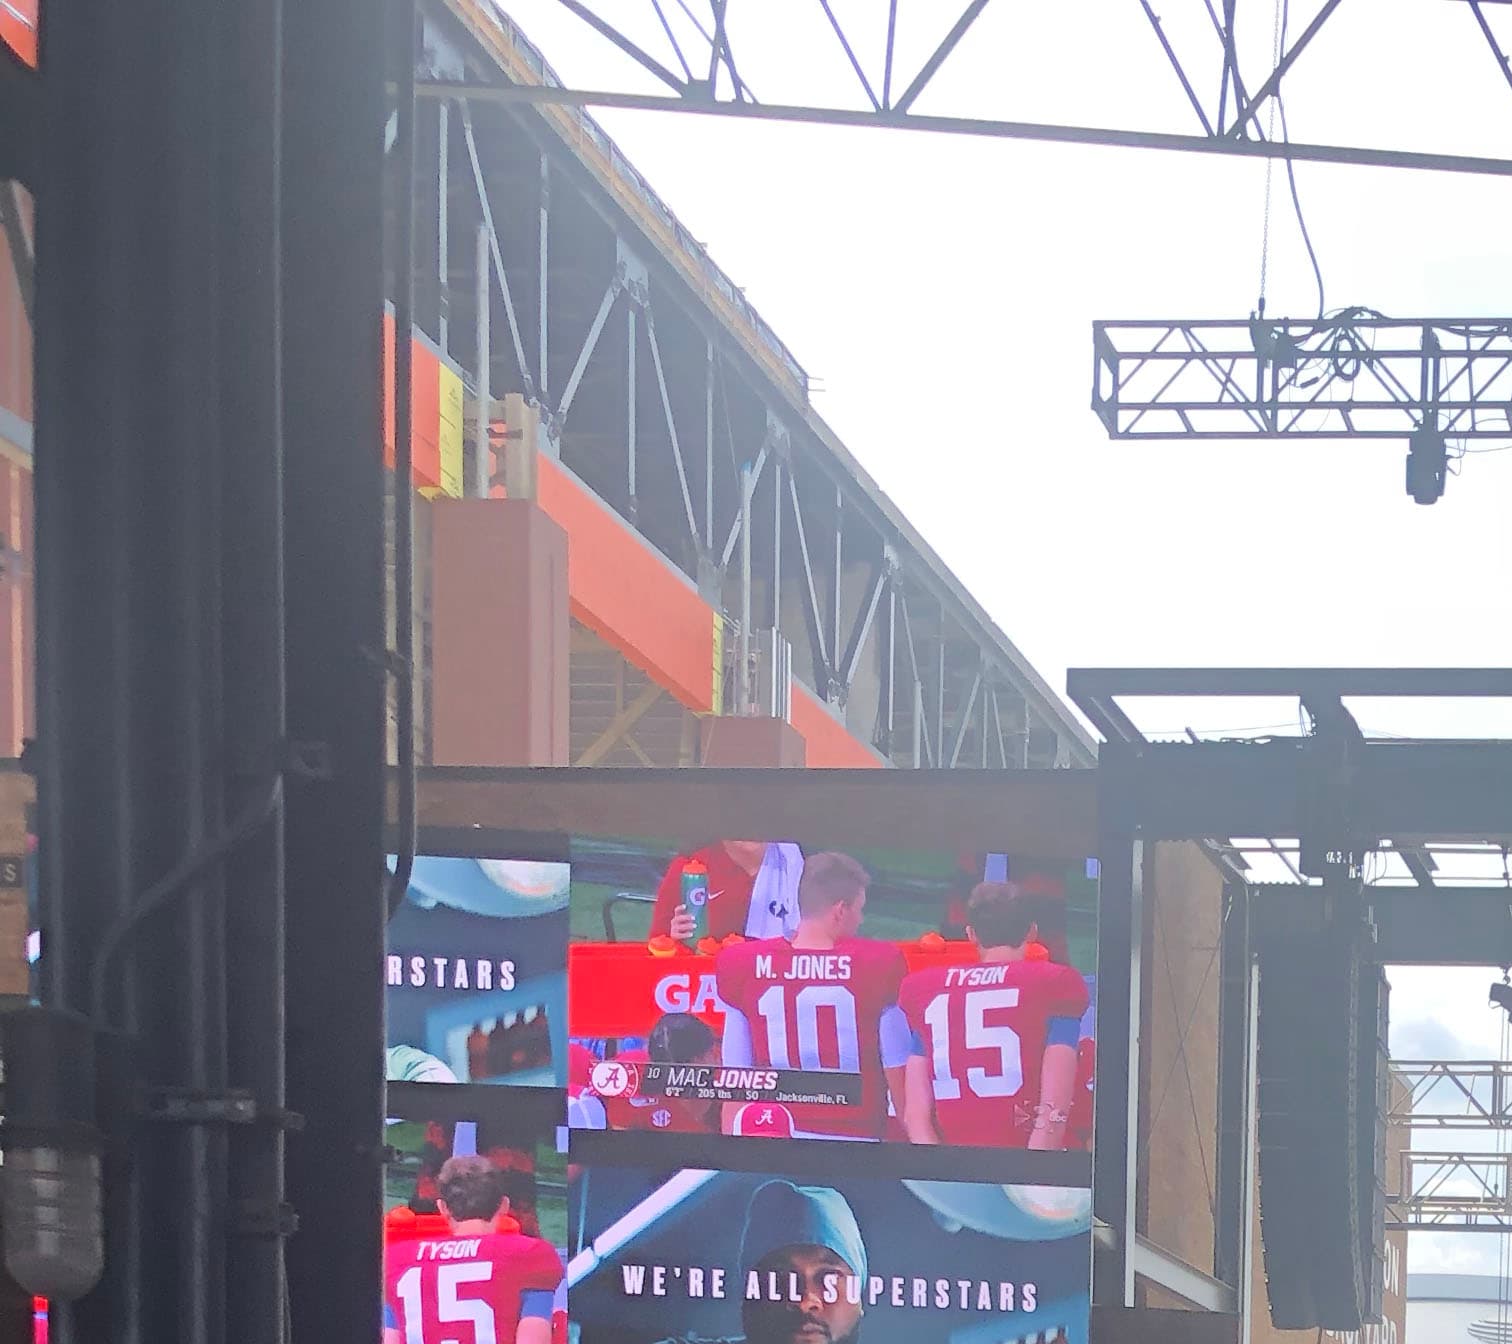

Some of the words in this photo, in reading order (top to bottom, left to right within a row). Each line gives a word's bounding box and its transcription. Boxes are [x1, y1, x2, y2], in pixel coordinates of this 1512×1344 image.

[386, 954, 516, 991] RSTARS
[755, 955, 777, 979] M.
[783, 955, 851, 980] JONES
[944, 964, 1009, 987] TYSON
[757, 985, 862, 1073] 10
[924, 988, 1024, 1100] 15
[647, 1067, 661, 1079] 10
[666, 1067, 710, 1088] MAC
[713, 1070, 779, 1091] JONES
[698, 1088, 716, 1099] 205
[775, 1091, 836, 1105] Jacksonville,
[416, 1238, 482, 1261] TYSON
[622, 1264, 727, 1299] WE'RE
[744, 1270, 803, 1302] ALL
[822, 1273, 1038, 1314] SUPERSTARS
